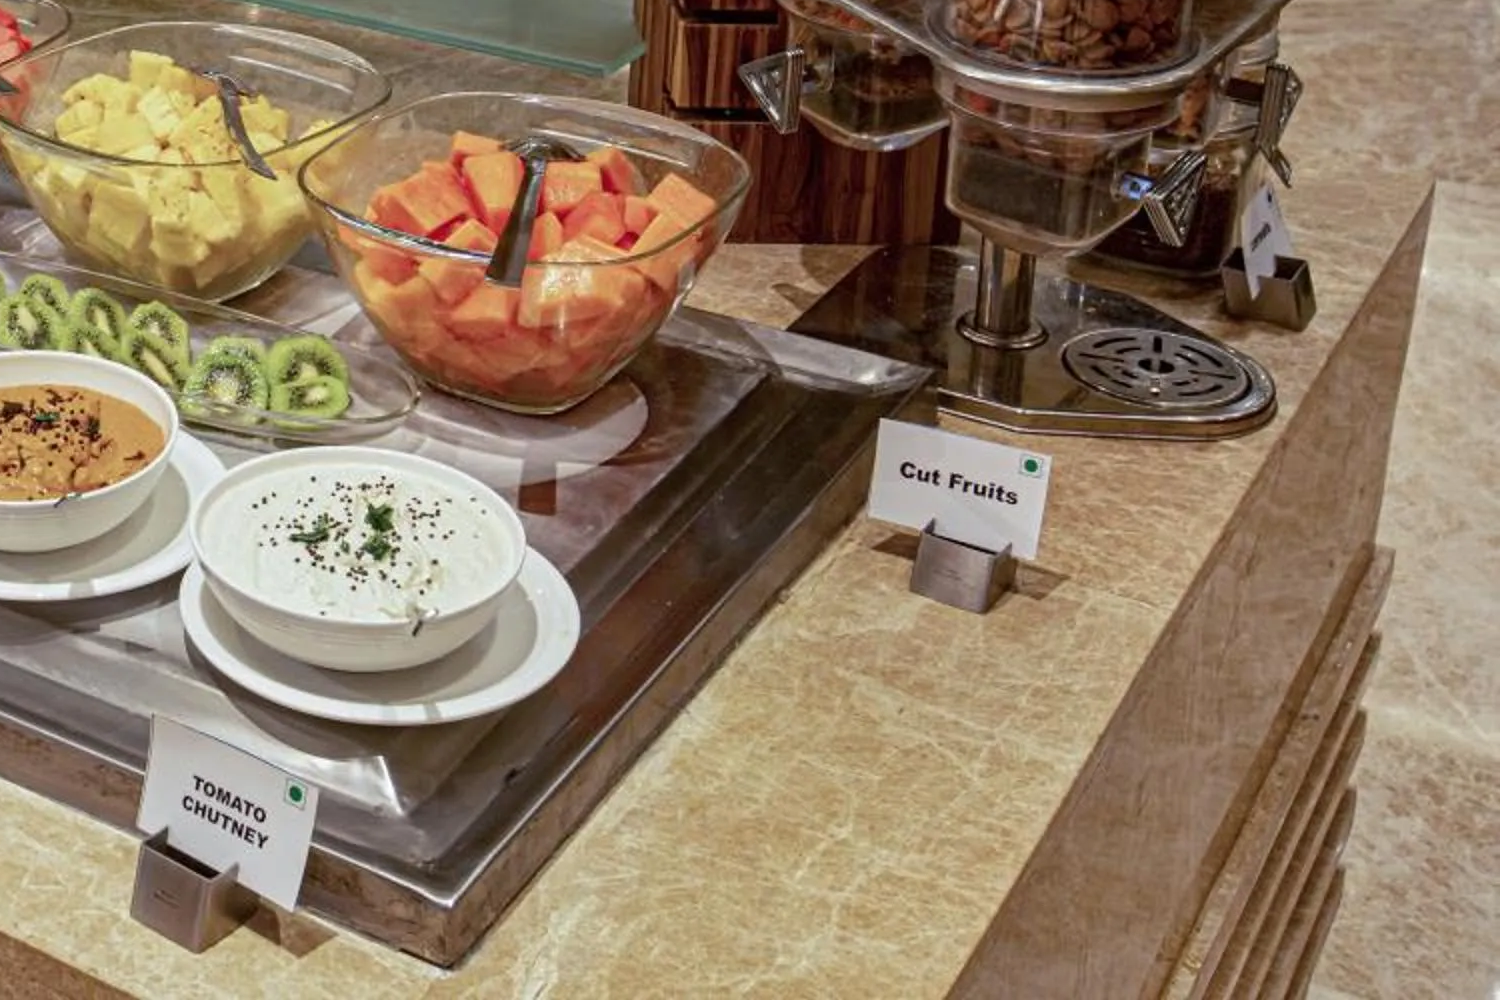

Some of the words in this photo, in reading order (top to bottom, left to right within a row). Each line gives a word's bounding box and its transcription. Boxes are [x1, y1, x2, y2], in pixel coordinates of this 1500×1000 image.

[900, 461, 941, 486] Cut
[948, 472, 1018, 505] Fruits
[182, 795, 269, 849] CHUTNEY
[193, 775, 267, 823] TOMATO
